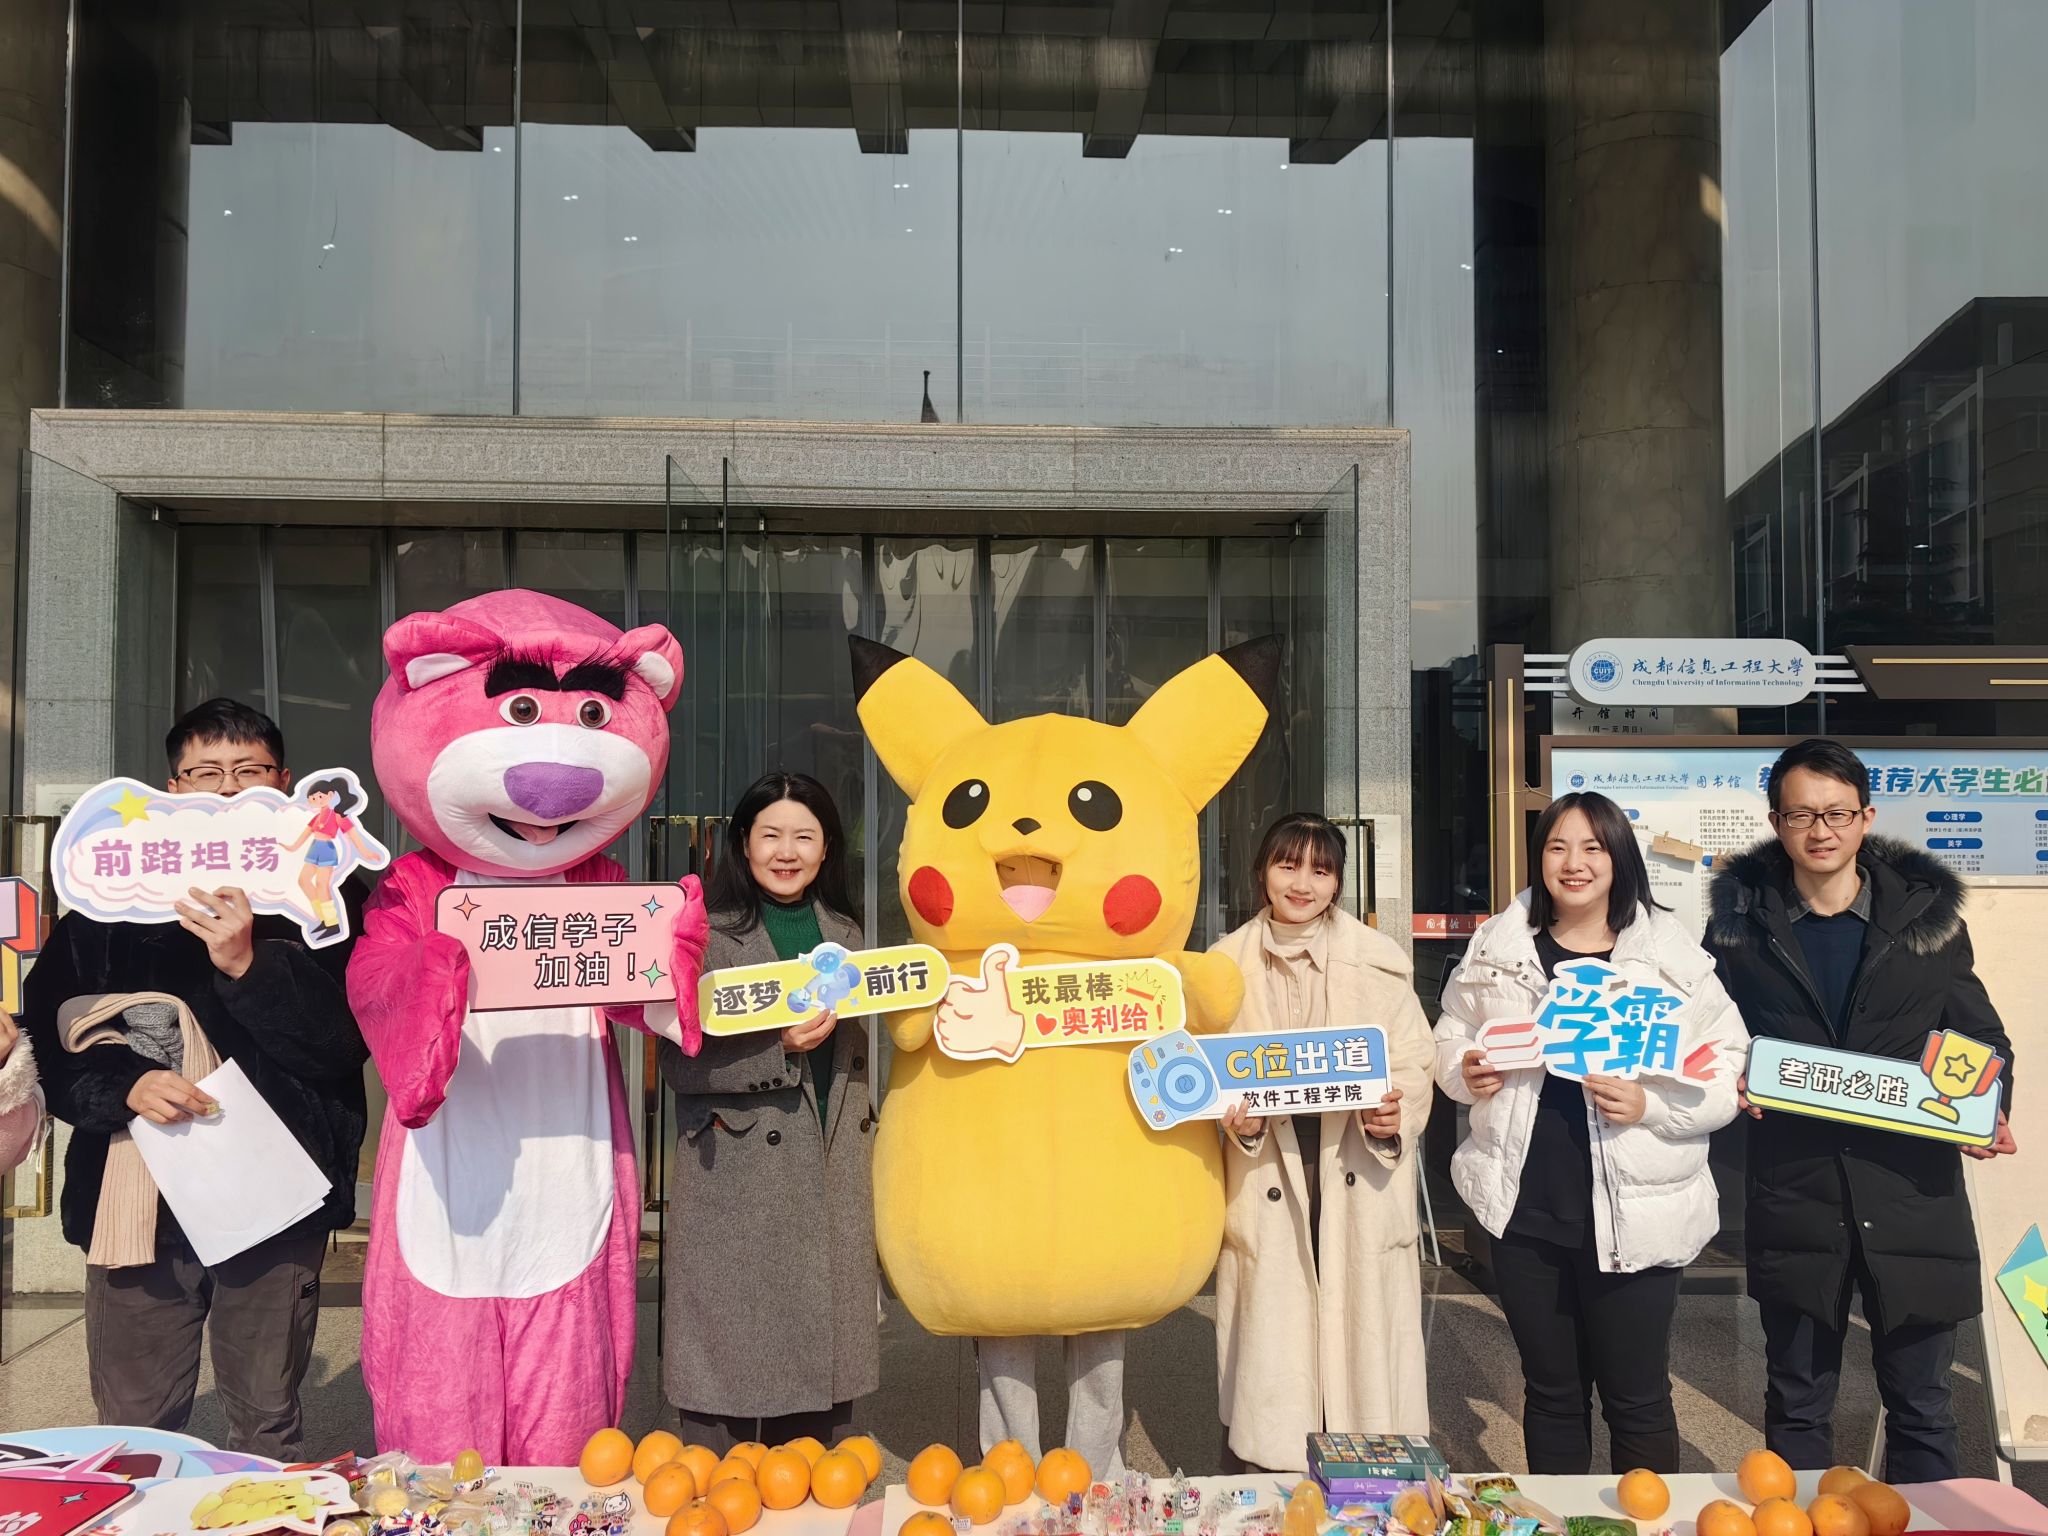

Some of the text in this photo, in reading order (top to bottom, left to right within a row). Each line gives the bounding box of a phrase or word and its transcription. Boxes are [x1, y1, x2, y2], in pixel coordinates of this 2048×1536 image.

[1632, 679, 1665, 687] Chengdu
[1667, 679, 1704, 687] University
[1762, 679, 1804, 687] Technology
[1943, 813, 1966, 821] 心理学
[91, 837, 281, 878] 前路坦荡
[480, 912, 638, 951] 成信学子
[534, 952, 638, 990] 加油！
[712, 960, 930, 1017] 逐梦 前行
[1021, 972, 1115, 1006] 我最棒
[1061, 1003, 1166, 1037] 奥利给！
[1537, 984, 1684, 1076] 学霸
[1226, 1036, 1373, 1080] C位出道
[1242, 1084, 1363, 1110] 软件工程学院
[1779, 1057, 1910, 1107] 考研必胜
